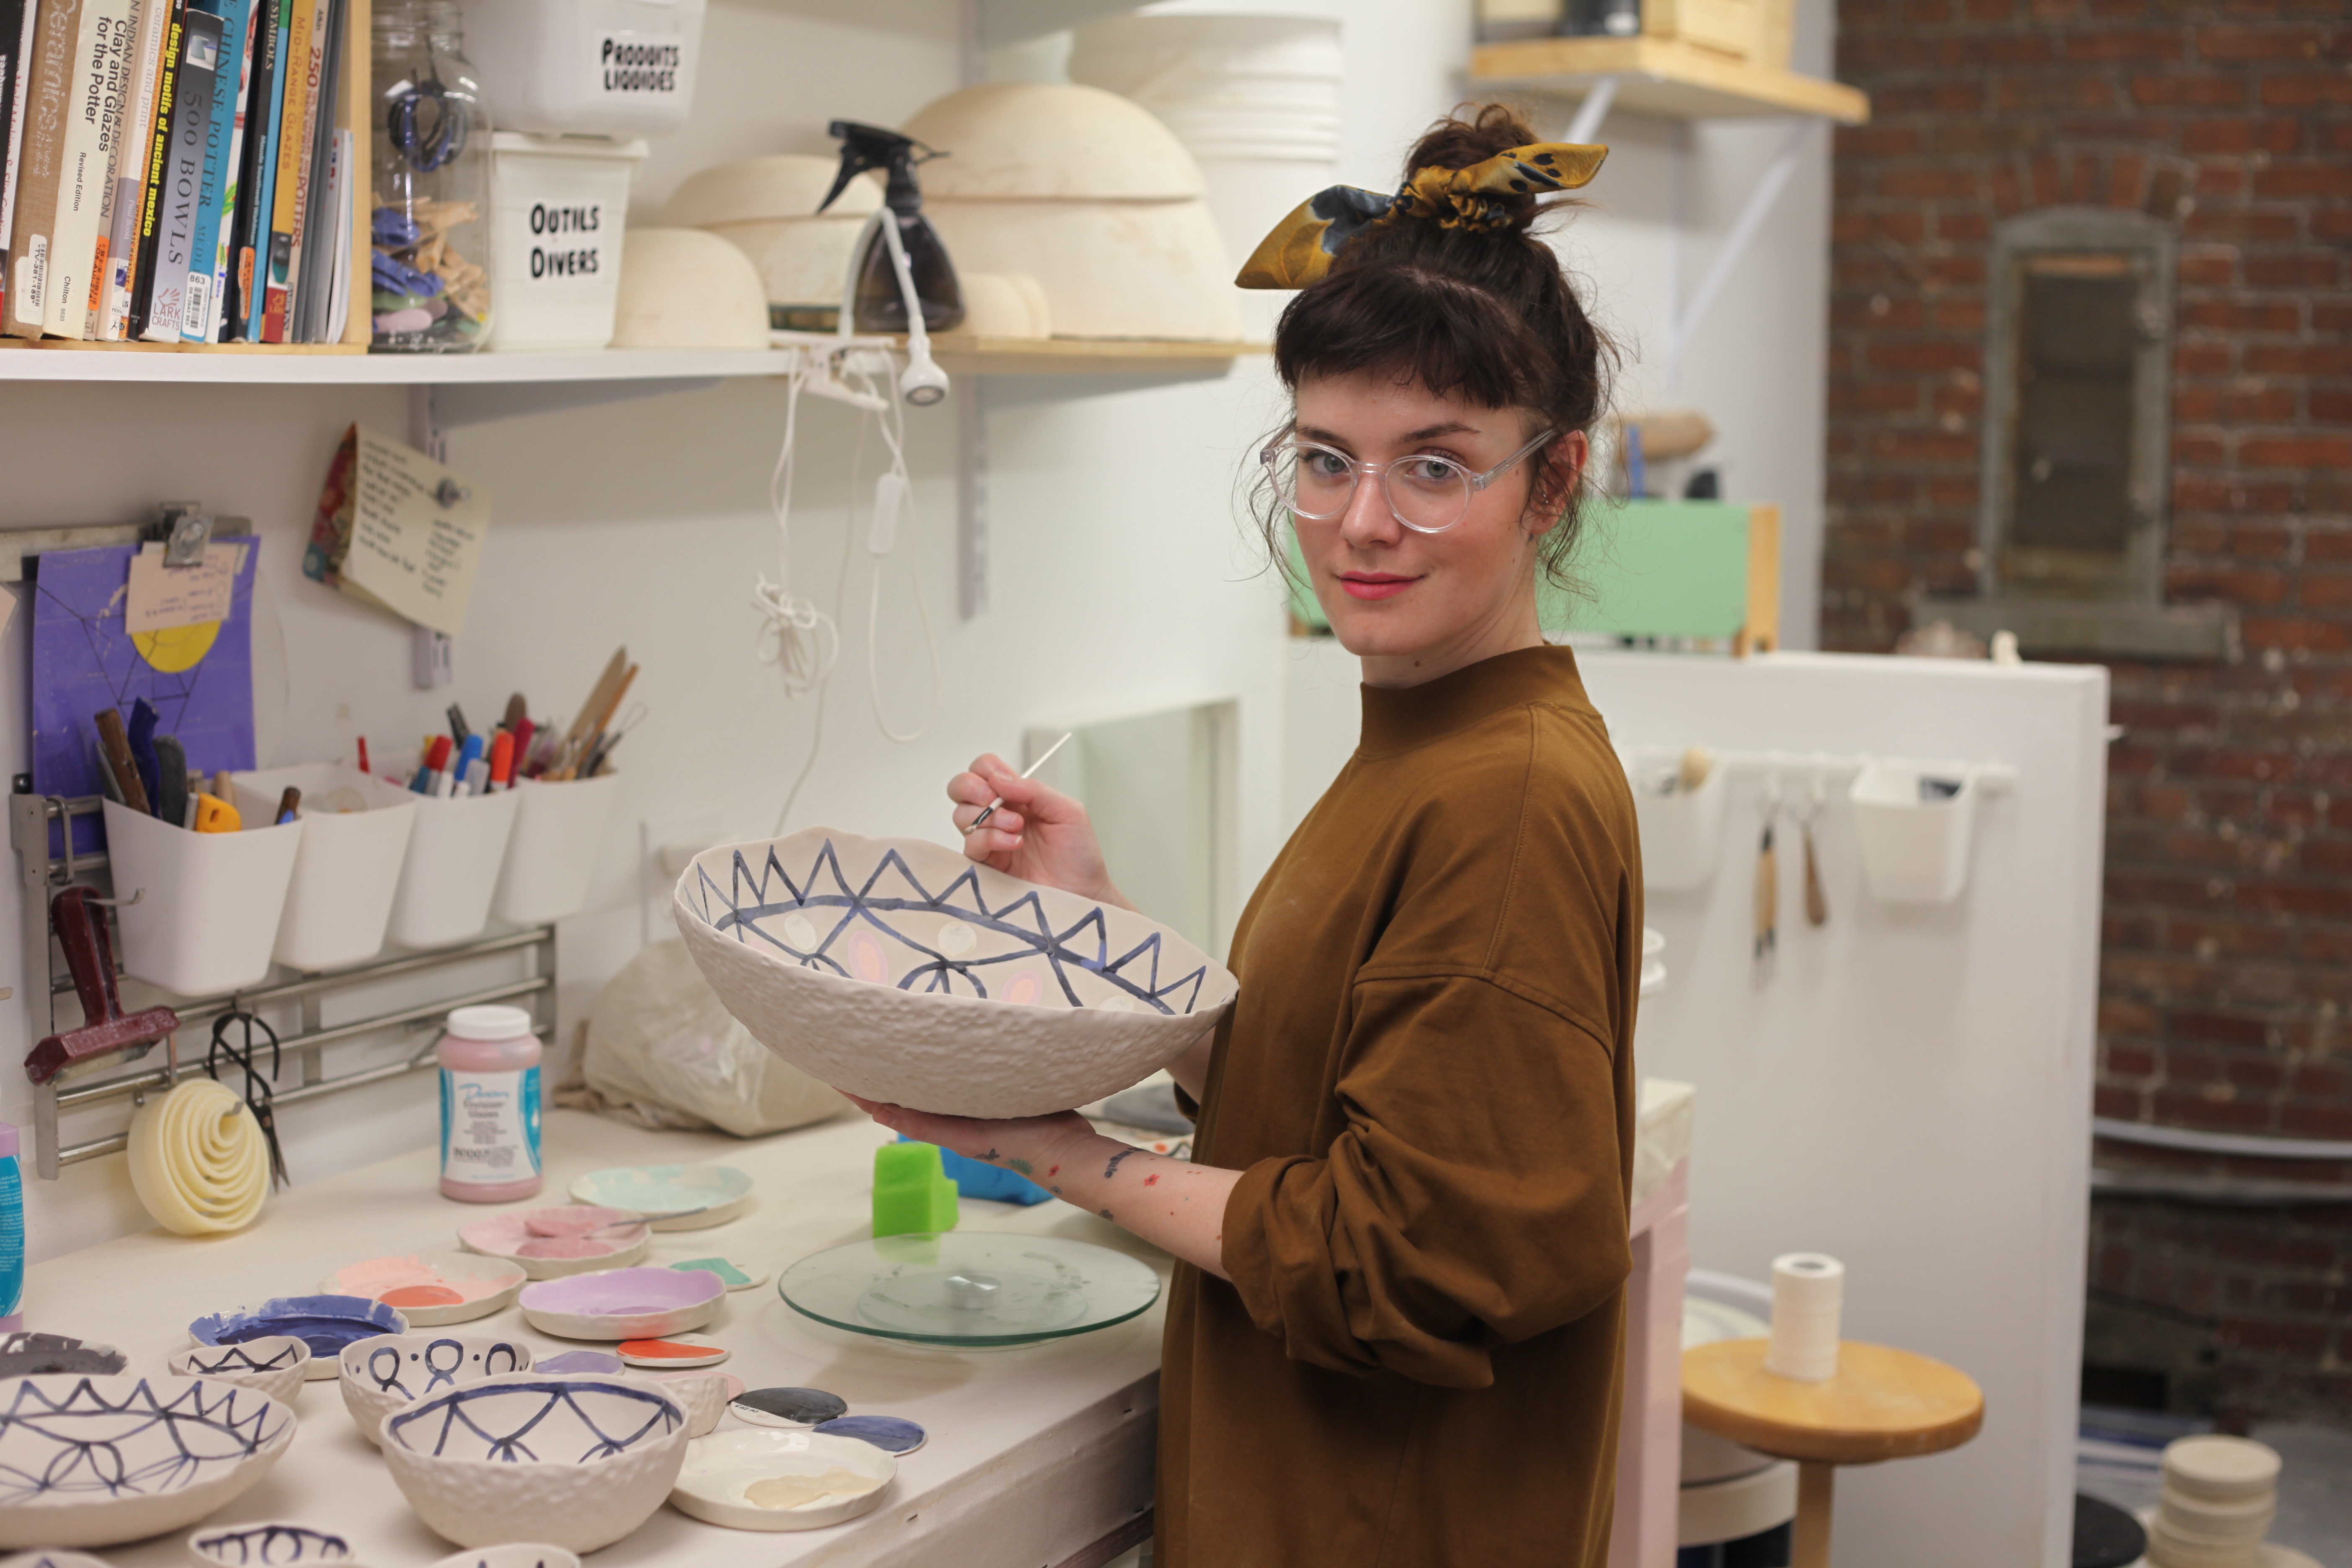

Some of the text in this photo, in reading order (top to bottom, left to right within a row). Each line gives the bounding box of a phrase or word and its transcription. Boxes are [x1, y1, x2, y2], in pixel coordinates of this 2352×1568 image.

[85, 16, 112, 124] for the Potter
[123, 15, 138, 63] INDIAN
[139, 8, 162, 128] ceramics and print
[211, 17, 234, 111] CHINESE
[266, 5, 279, 70] SYMBOLS
[307, 46, 321, 88] 250
[99, 20, 127, 152] Clay and Glazes
[115, 67, 130, 115] DESIGN
[283, 17, 306, 170] MID-RANGE GLAZES
[143, 23, 182, 237] design motifs of ancient mexico
[73, 152, 86, 211] Revised Edition
[101, 130, 121, 218] DECORATION
[168, 90, 202, 265] 500 BOWLS
[199, 120, 221, 207] POTTER
[291, 176, 307, 248] POTTERS
[531, 203, 601, 235] OUTILS
[62, 276, 71, 303] Chilton
[190, 275, 205, 284] 863
[531, 248, 598, 279] DIVERS
[152, 316, 180, 330] CRAFTS
[154, 303, 181, 320] LARK
